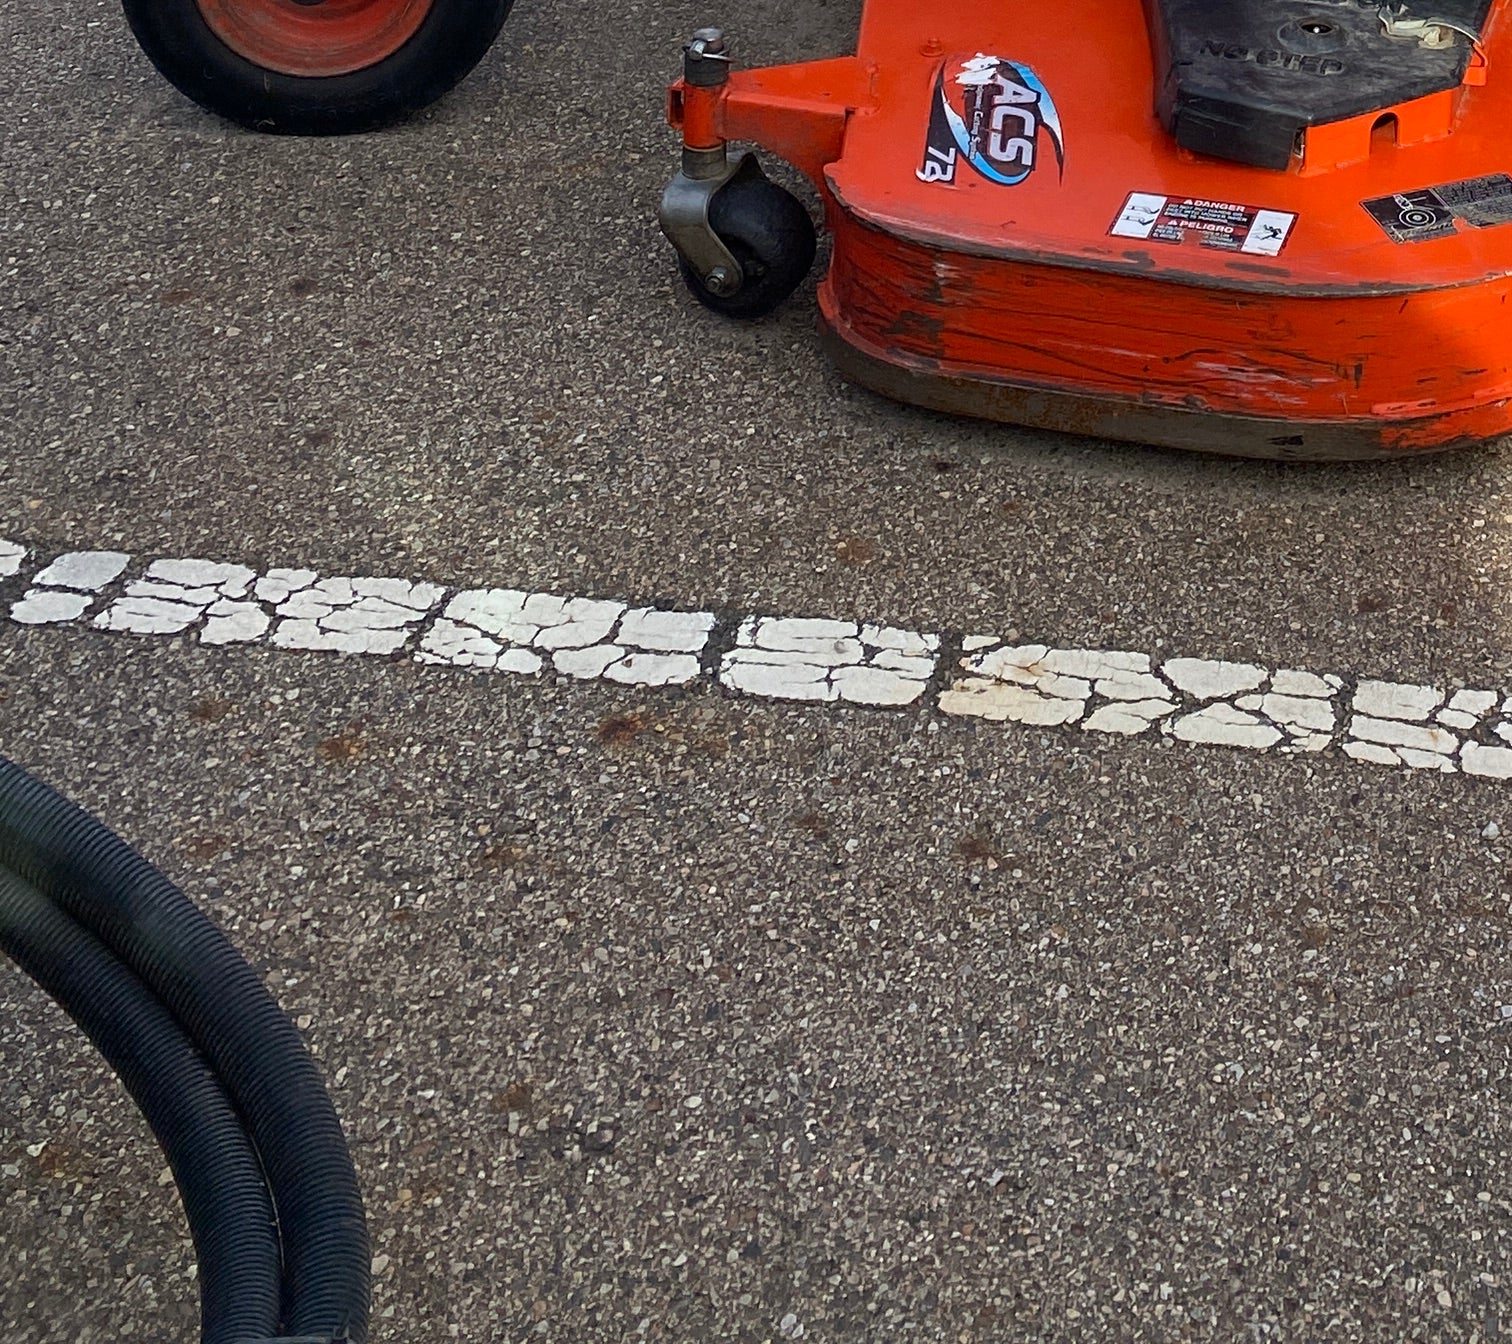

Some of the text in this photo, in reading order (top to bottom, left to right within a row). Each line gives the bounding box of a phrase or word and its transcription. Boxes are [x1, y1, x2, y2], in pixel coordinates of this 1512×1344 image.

[1256, 49, 1343, 75] STEP
[990, 74, 1037, 166] ACS
[924, 146, 956, 182] 72
[1194, 200, 1246, 212] DANGER
[1180, 220, 1234, 233] PELIGRO
